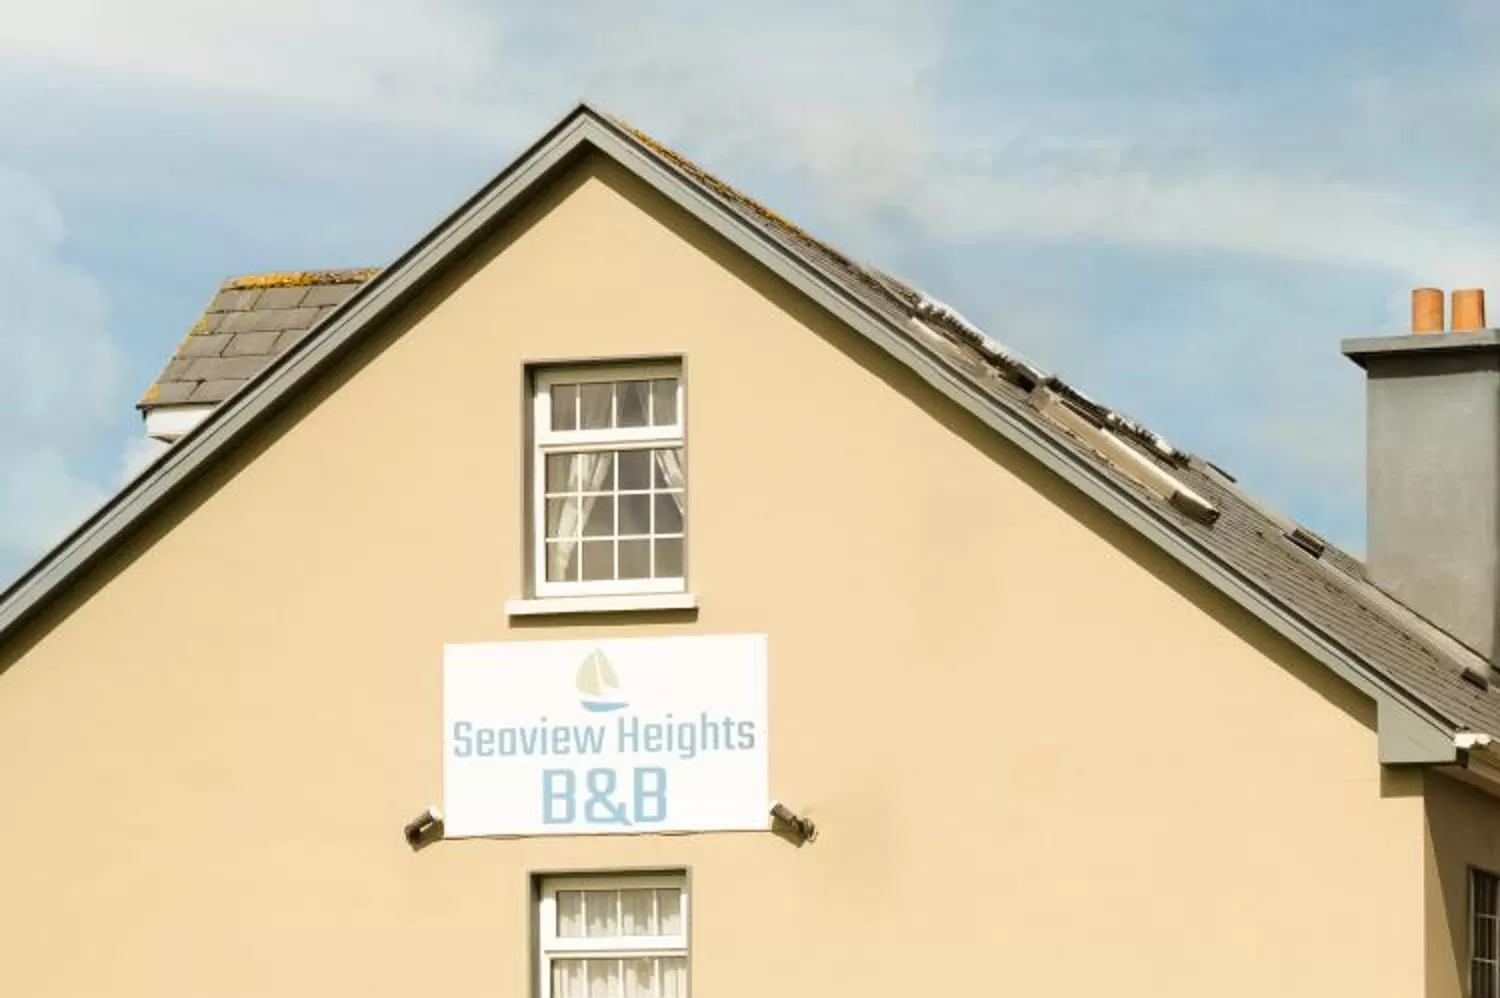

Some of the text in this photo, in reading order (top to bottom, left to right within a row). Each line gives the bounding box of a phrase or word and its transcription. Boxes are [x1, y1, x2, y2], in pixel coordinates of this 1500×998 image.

[453, 711, 756, 760] Seaview Heights
[542, 766, 668, 827] B&B
